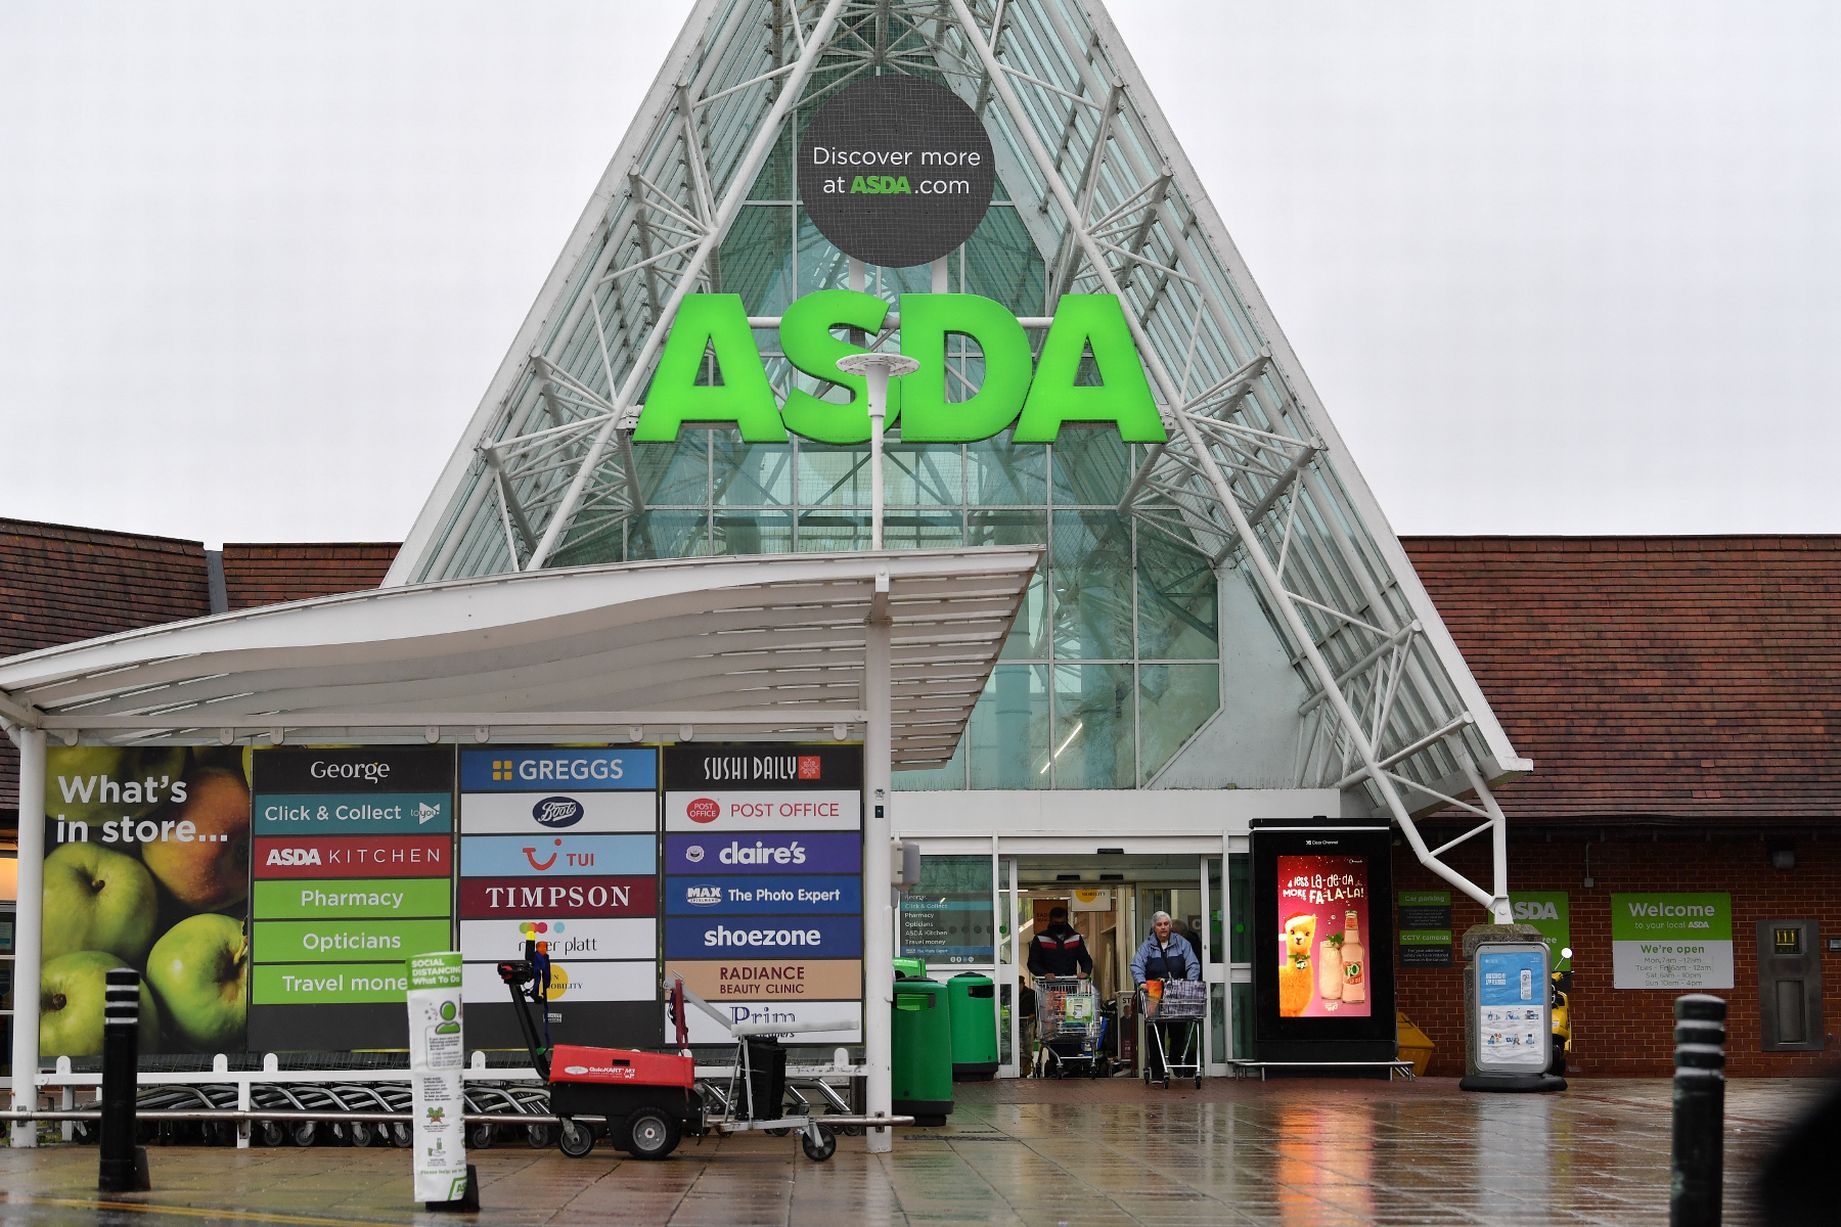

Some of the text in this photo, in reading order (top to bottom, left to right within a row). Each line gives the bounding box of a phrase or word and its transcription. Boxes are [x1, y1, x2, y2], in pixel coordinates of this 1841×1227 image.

[813, 147, 981, 166] Discover more
[823, 175, 969, 194] at ASDA .com
[632, 289, 1168, 446] ASDA
[310, 761, 390, 784] George
[519, 759, 624, 780] GREGGS
[704, 756, 797, 780] SUSHI DAILY
[57, 774, 187, 804] What's
[265, 805, 311, 821] Click
[316, 805, 329, 821] &
[335, 804, 402, 820] Collect
[537, 801, 577, 822] Boots
[689, 809, 717, 817] OFFICE
[694, 802, 714, 810] POST
[731, 803, 839, 817] POST OFFICE
[57, 814, 228, 843] in store...
[266, 848, 440, 866] ASDA KITCHEN
[566, 853, 595, 867] TUI
[719, 841, 806, 865] claire's
[301, 889, 403, 908] Pharmacy
[485, 886, 631, 908] TIMPSON
[687, 887, 721, 897] MAX
[728, 888, 841, 904] The Photo Expert
[1418, 895, 1445, 903] parking
[1628, 902, 1715, 917] Welcome
[1646, 923, 1664, 931] your
[1666, 921, 1686, 929] local
[1687, 921, 1709, 929] ASDA
[303, 932, 401, 952] Opticians
[704, 925, 821, 946] shoezone
[518, 936, 598, 955] rer platt
[1640, 944, 1705, 956] We're open
[411, 958, 444, 968] SOCIAL
[413, 976, 436, 985] What
[439, 975, 449, 984] To
[720, 966, 805, 980] RADIANCE
[282, 974, 408, 991] Travel mone
[720, 984, 804, 994] BEAUTY CLINIC
[729, 1006, 796, 1025] Prim
